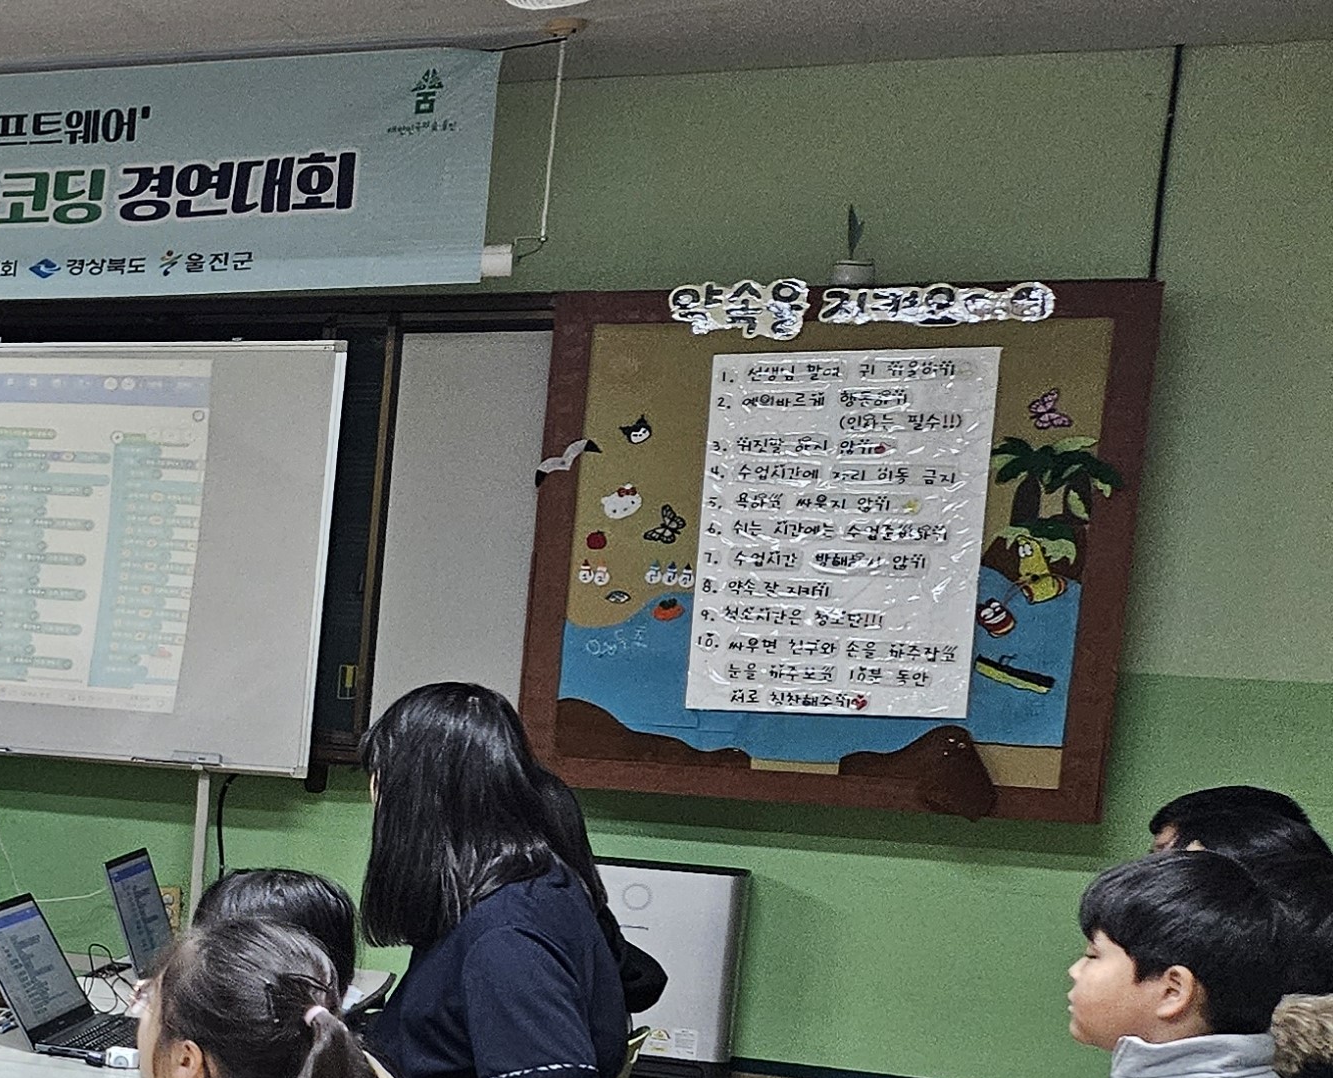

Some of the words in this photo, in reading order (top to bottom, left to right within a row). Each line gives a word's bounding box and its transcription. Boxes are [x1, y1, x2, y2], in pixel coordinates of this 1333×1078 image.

[118, 152, 357, 223] 경연대회
[66, 256, 147, 276] 경상북도
[184, 251, 254, 273] 울진군
[717, 396, 731, 409] 2.
[712, 440, 728, 452] 3.
[738, 463, 819, 480] 수업시간에
[922, 467, 956, 485] 금지
[795, 494, 846, 510] 싸우지
[707, 522, 722, 535] 6.
[702, 578, 718, 594] 8.
[728, 579, 756, 596] 약속
[701, 609, 715, 622] 9.
[728, 662, 758, 681] 눈을
[896, 669, 930, 687] 동안
